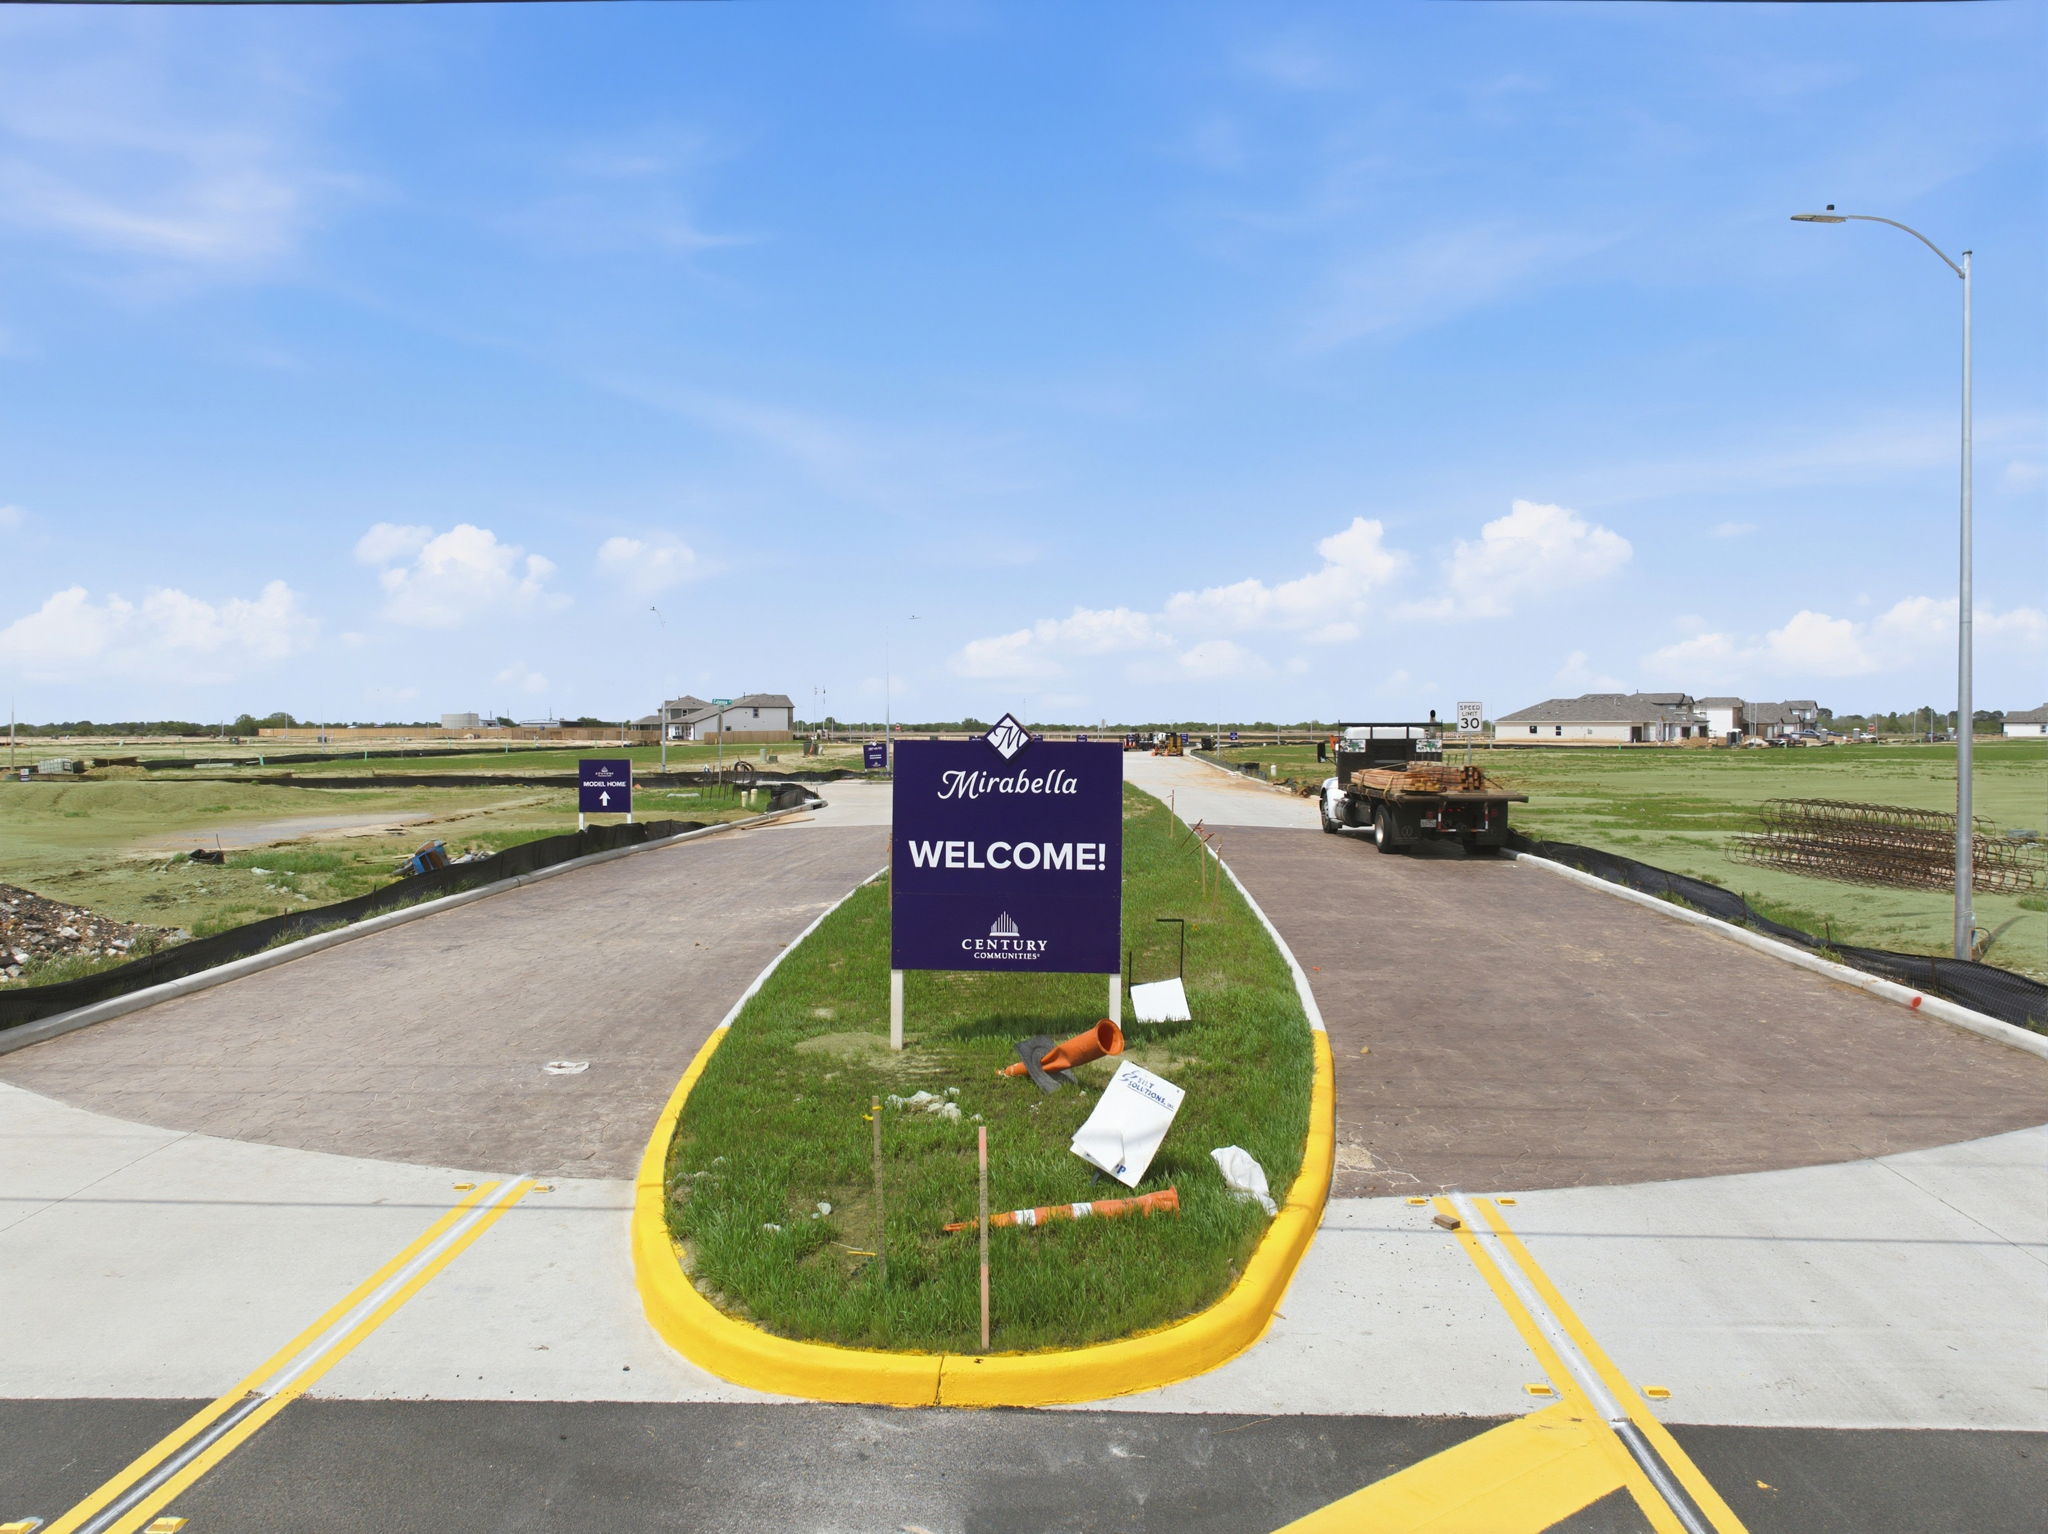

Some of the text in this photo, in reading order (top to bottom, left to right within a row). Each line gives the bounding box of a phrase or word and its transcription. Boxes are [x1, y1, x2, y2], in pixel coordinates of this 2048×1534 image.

[1460, 717, 1480, 729] 30
[937, 769, 1077, 799] Mirabella
[908, 840, 1106, 871] WELCOME!
[961, 939, 1048, 951] CENTURY
